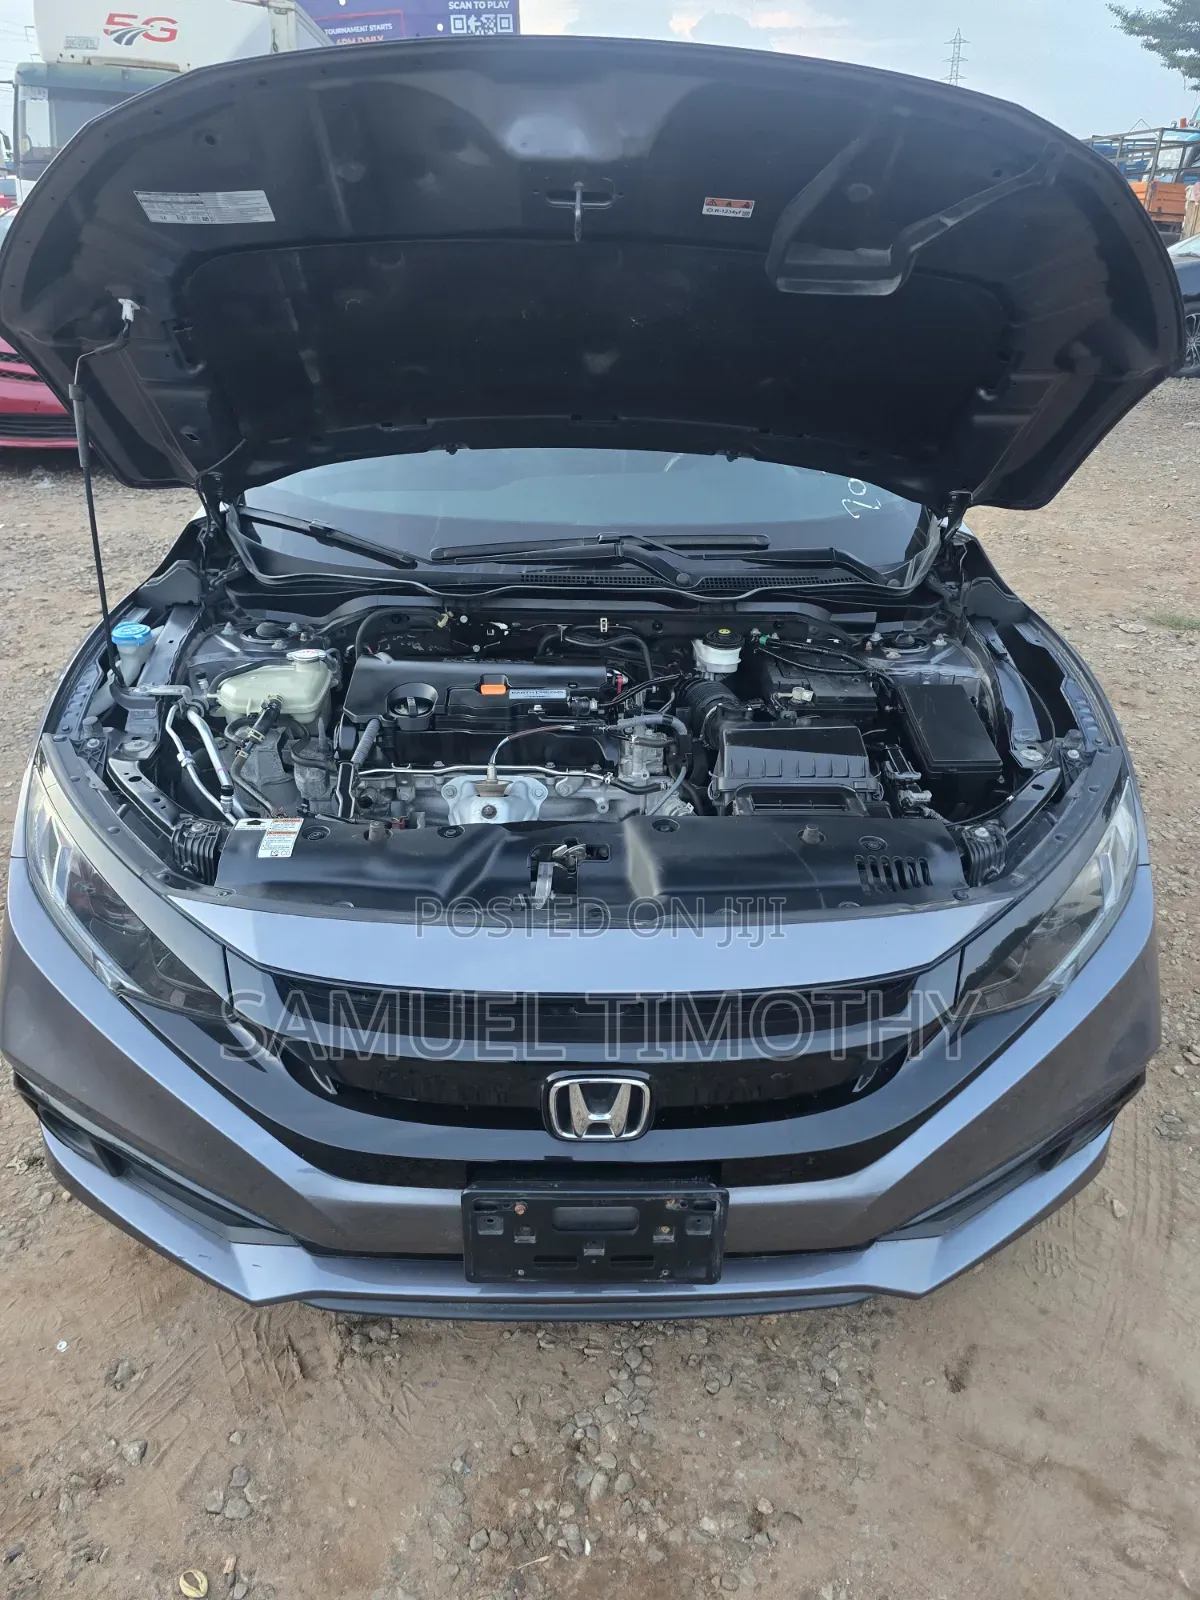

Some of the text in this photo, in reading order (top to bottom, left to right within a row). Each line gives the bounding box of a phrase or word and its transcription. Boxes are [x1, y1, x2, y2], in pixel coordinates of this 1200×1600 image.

[448, 1, 510, 9] SCAN TO PLAY
[103, 13, 178, 44] 5G
[324, 23, 393, 35] TOURNAMENT STARTS
